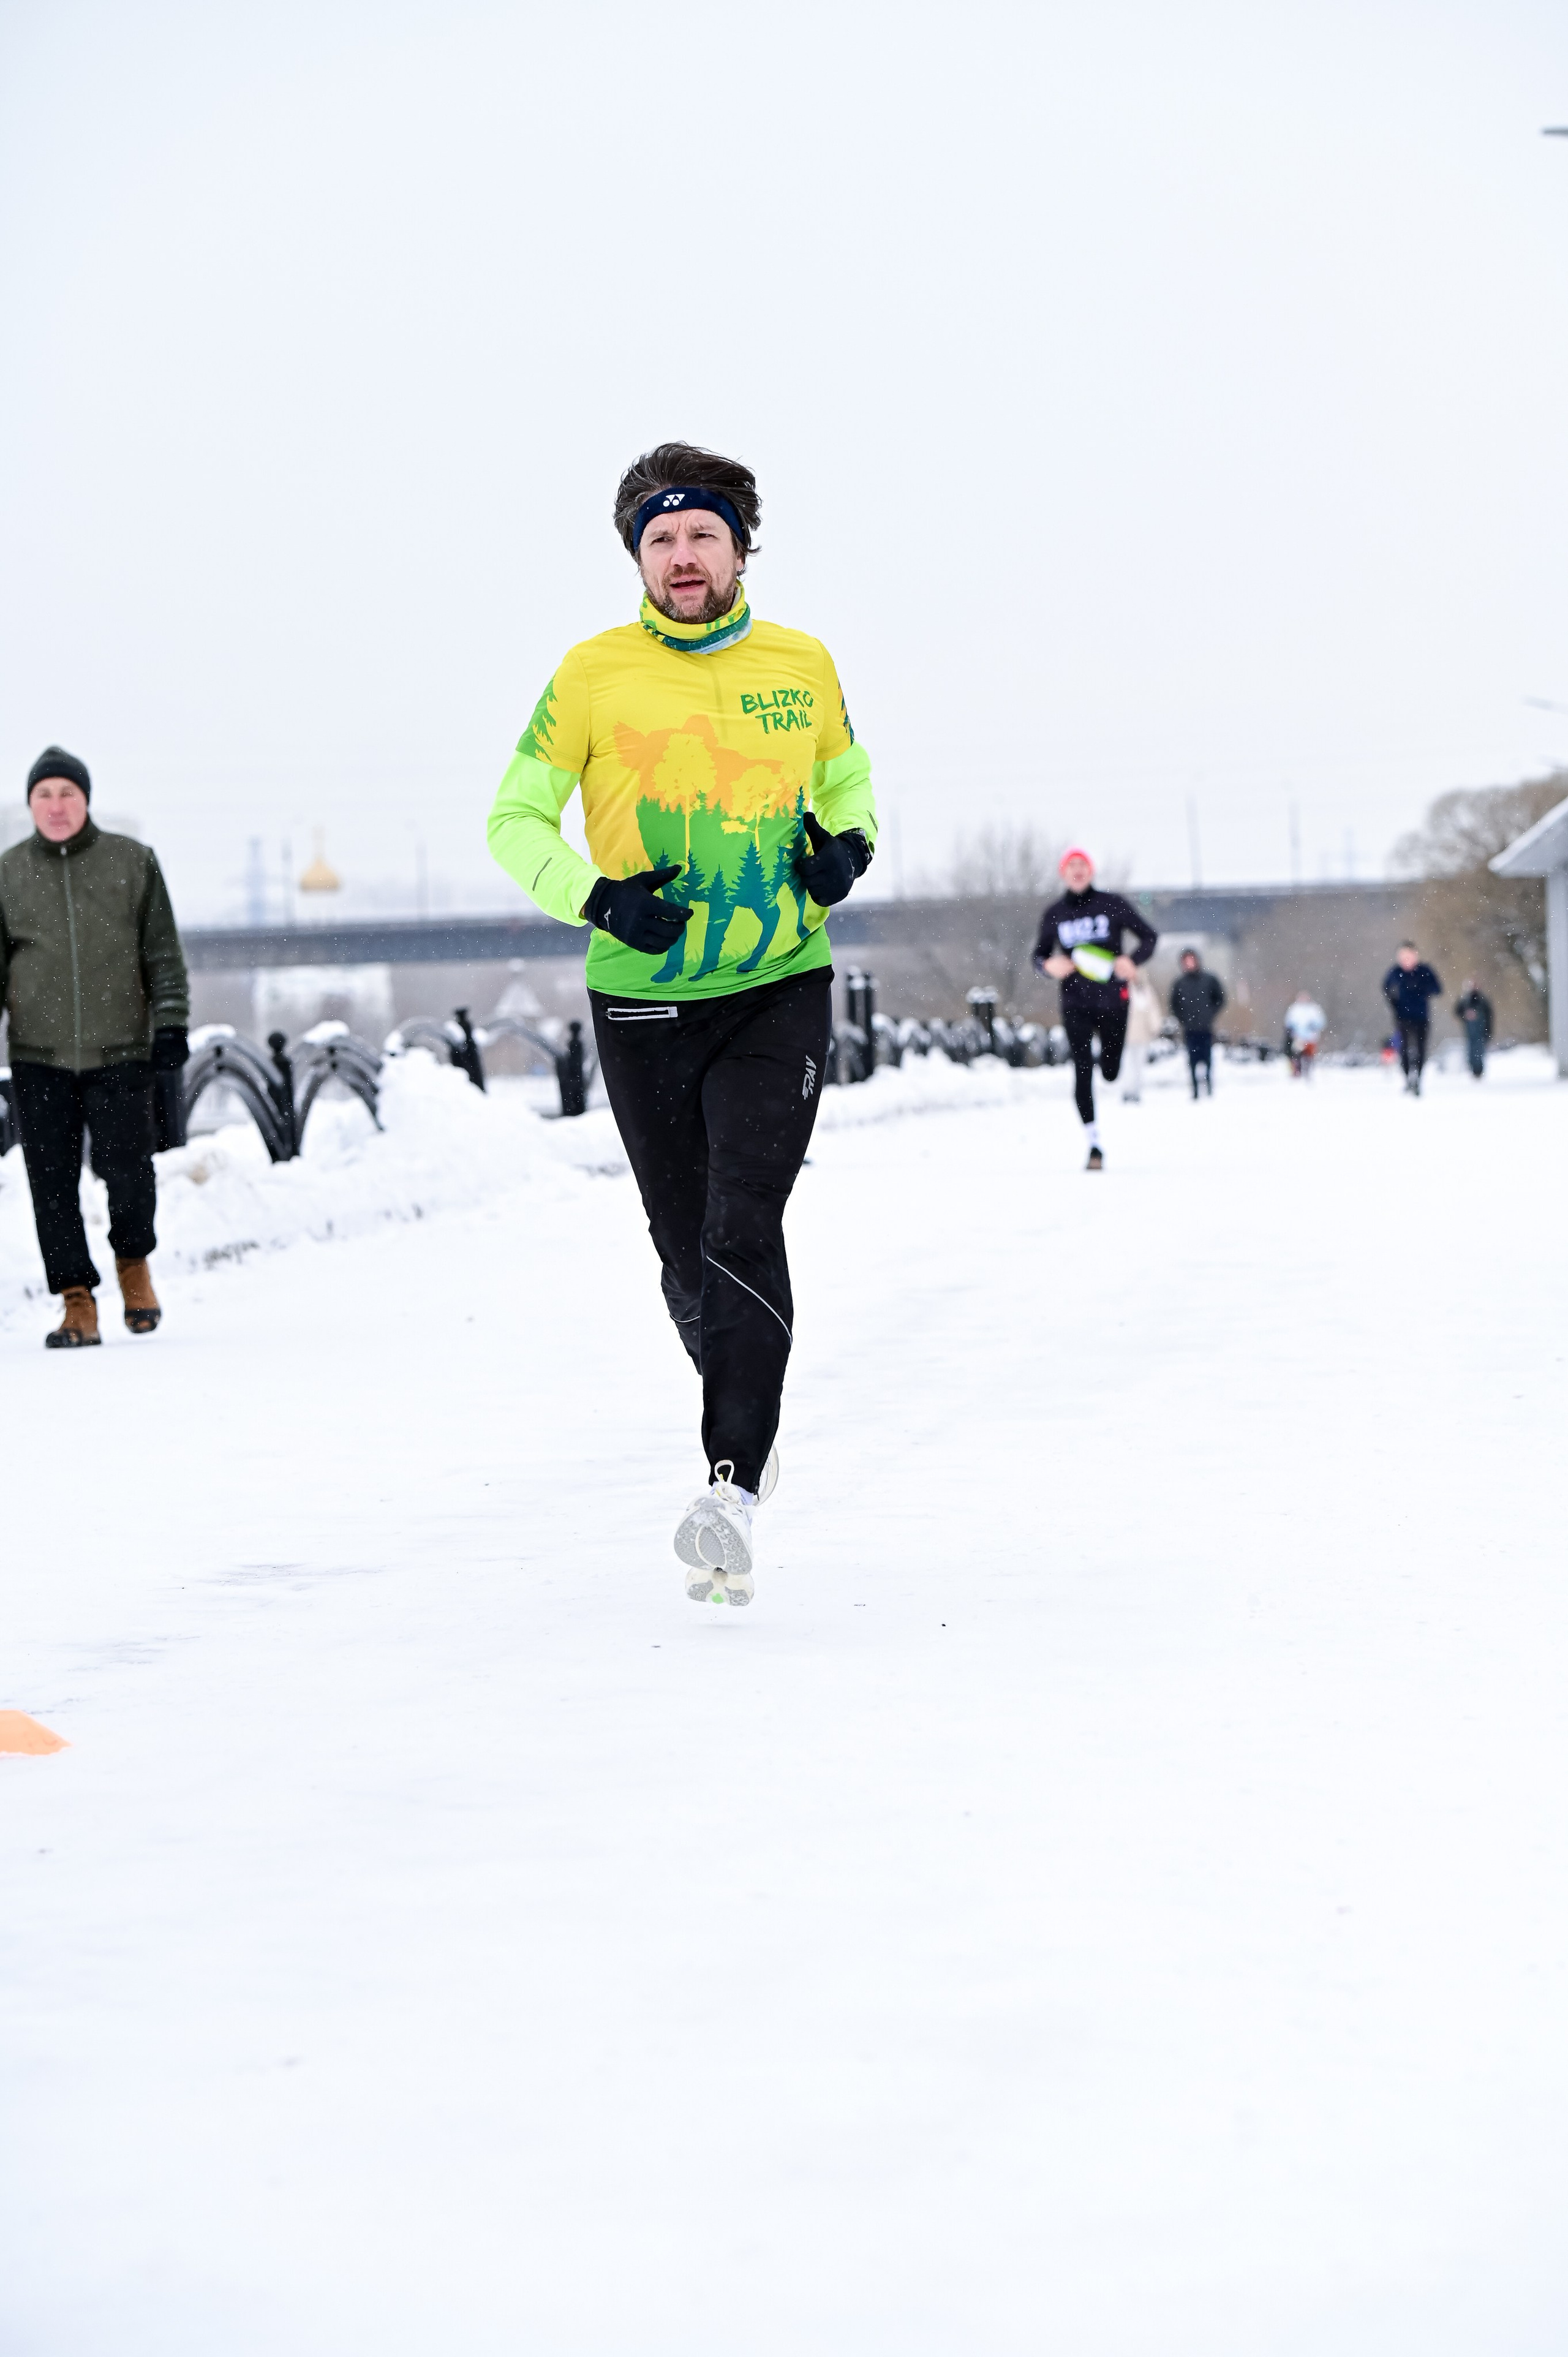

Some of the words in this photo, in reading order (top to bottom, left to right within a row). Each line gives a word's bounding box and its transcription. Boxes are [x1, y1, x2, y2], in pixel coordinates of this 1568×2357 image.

[740, 688, 814, 714] BLIZKO
[755, 709, 812, 734] TRAIL
[802, 1055, 816, 1100] RAY
